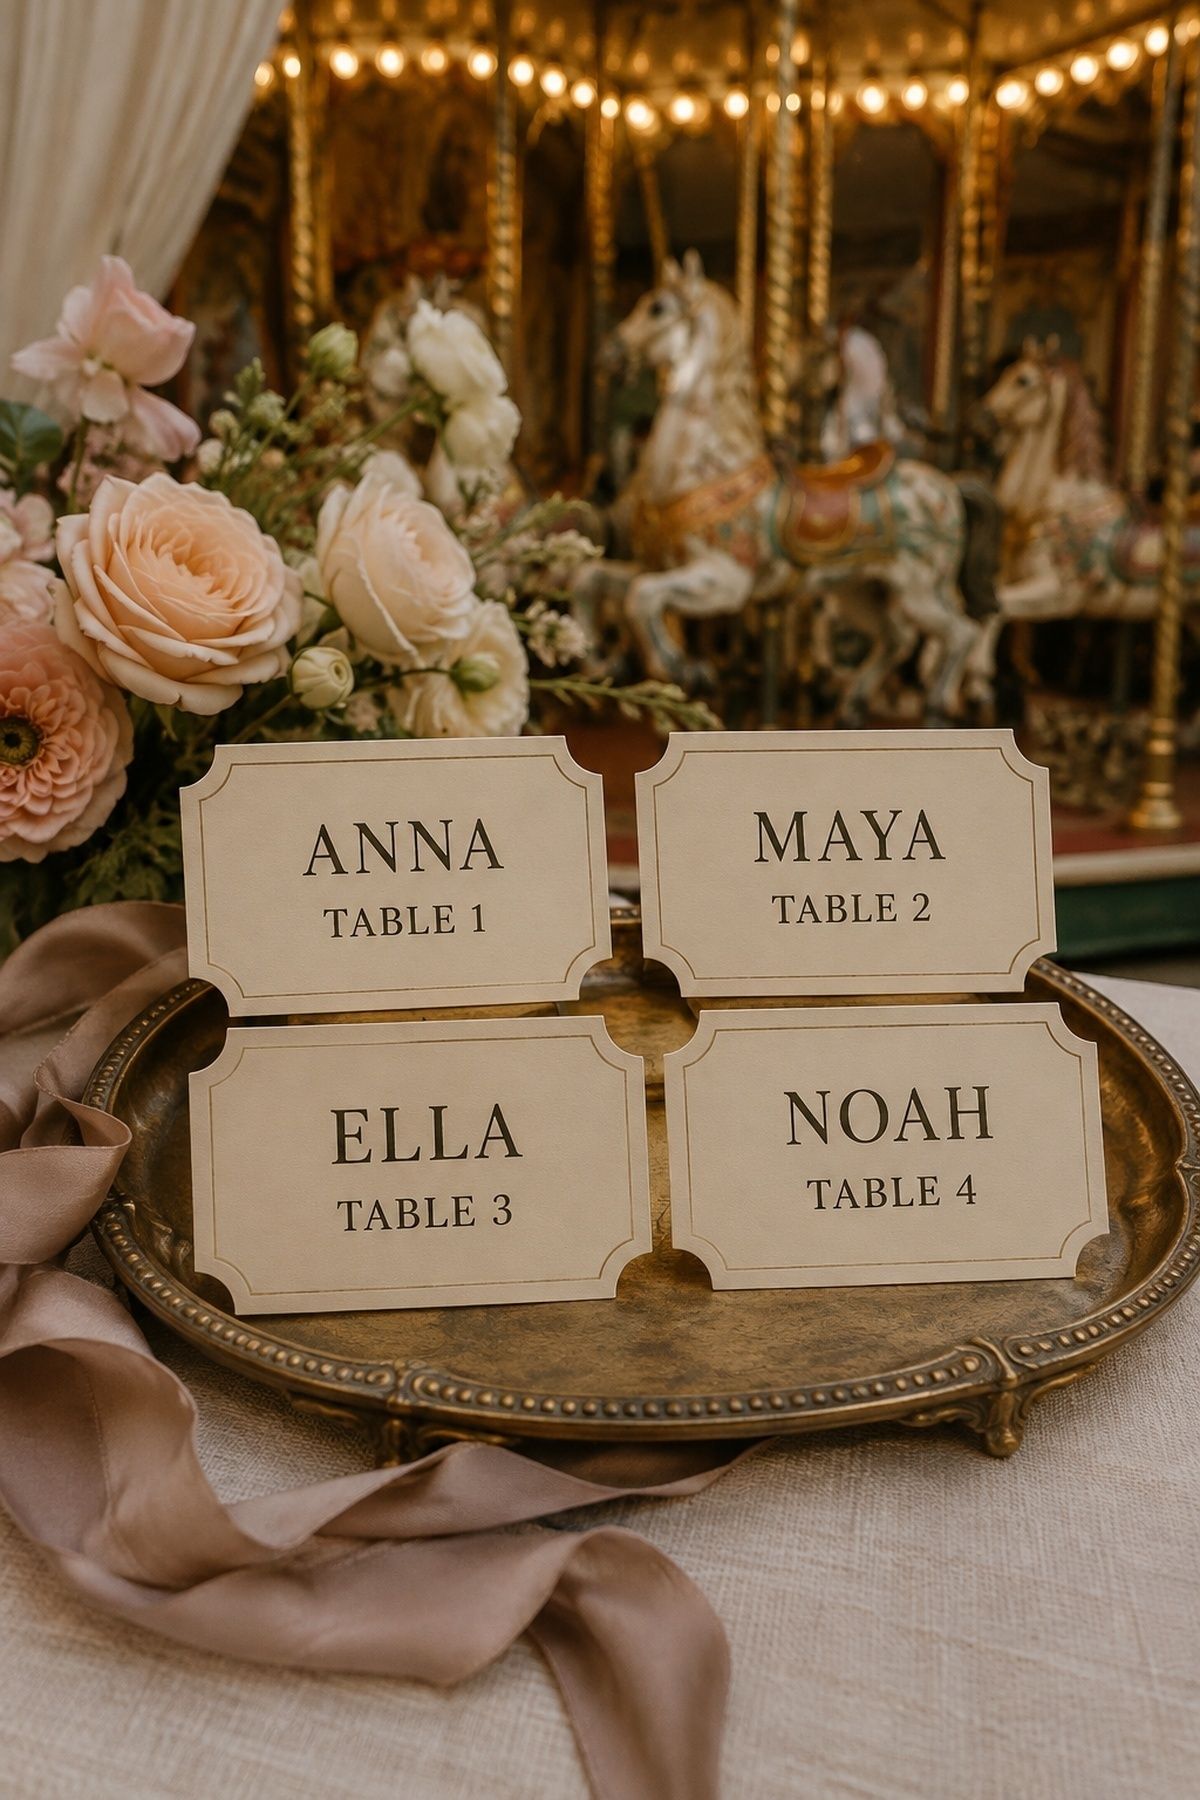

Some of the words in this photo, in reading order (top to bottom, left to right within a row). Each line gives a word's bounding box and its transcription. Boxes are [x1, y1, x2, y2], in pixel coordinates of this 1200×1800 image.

[302, 818, 505, 877] ANNA
[753, 808, 947, 863] MAYA
[323, 904, 456, 939] TABLE
[471, 903, 486, 933] 1
[771, 892, 895, 924] TABLE
[912, 892, 931, 922] 2
[330, 1102, 524, 1165] ELLA
[783, 1085, 994, 1146] NOAH
[336, 1195, 476, 1232] TABLE
[492, 1193, 513, 1226] 3
[806, 1175, 941, 1210] TABLE
[955, 1174, 977, 1205] 4
